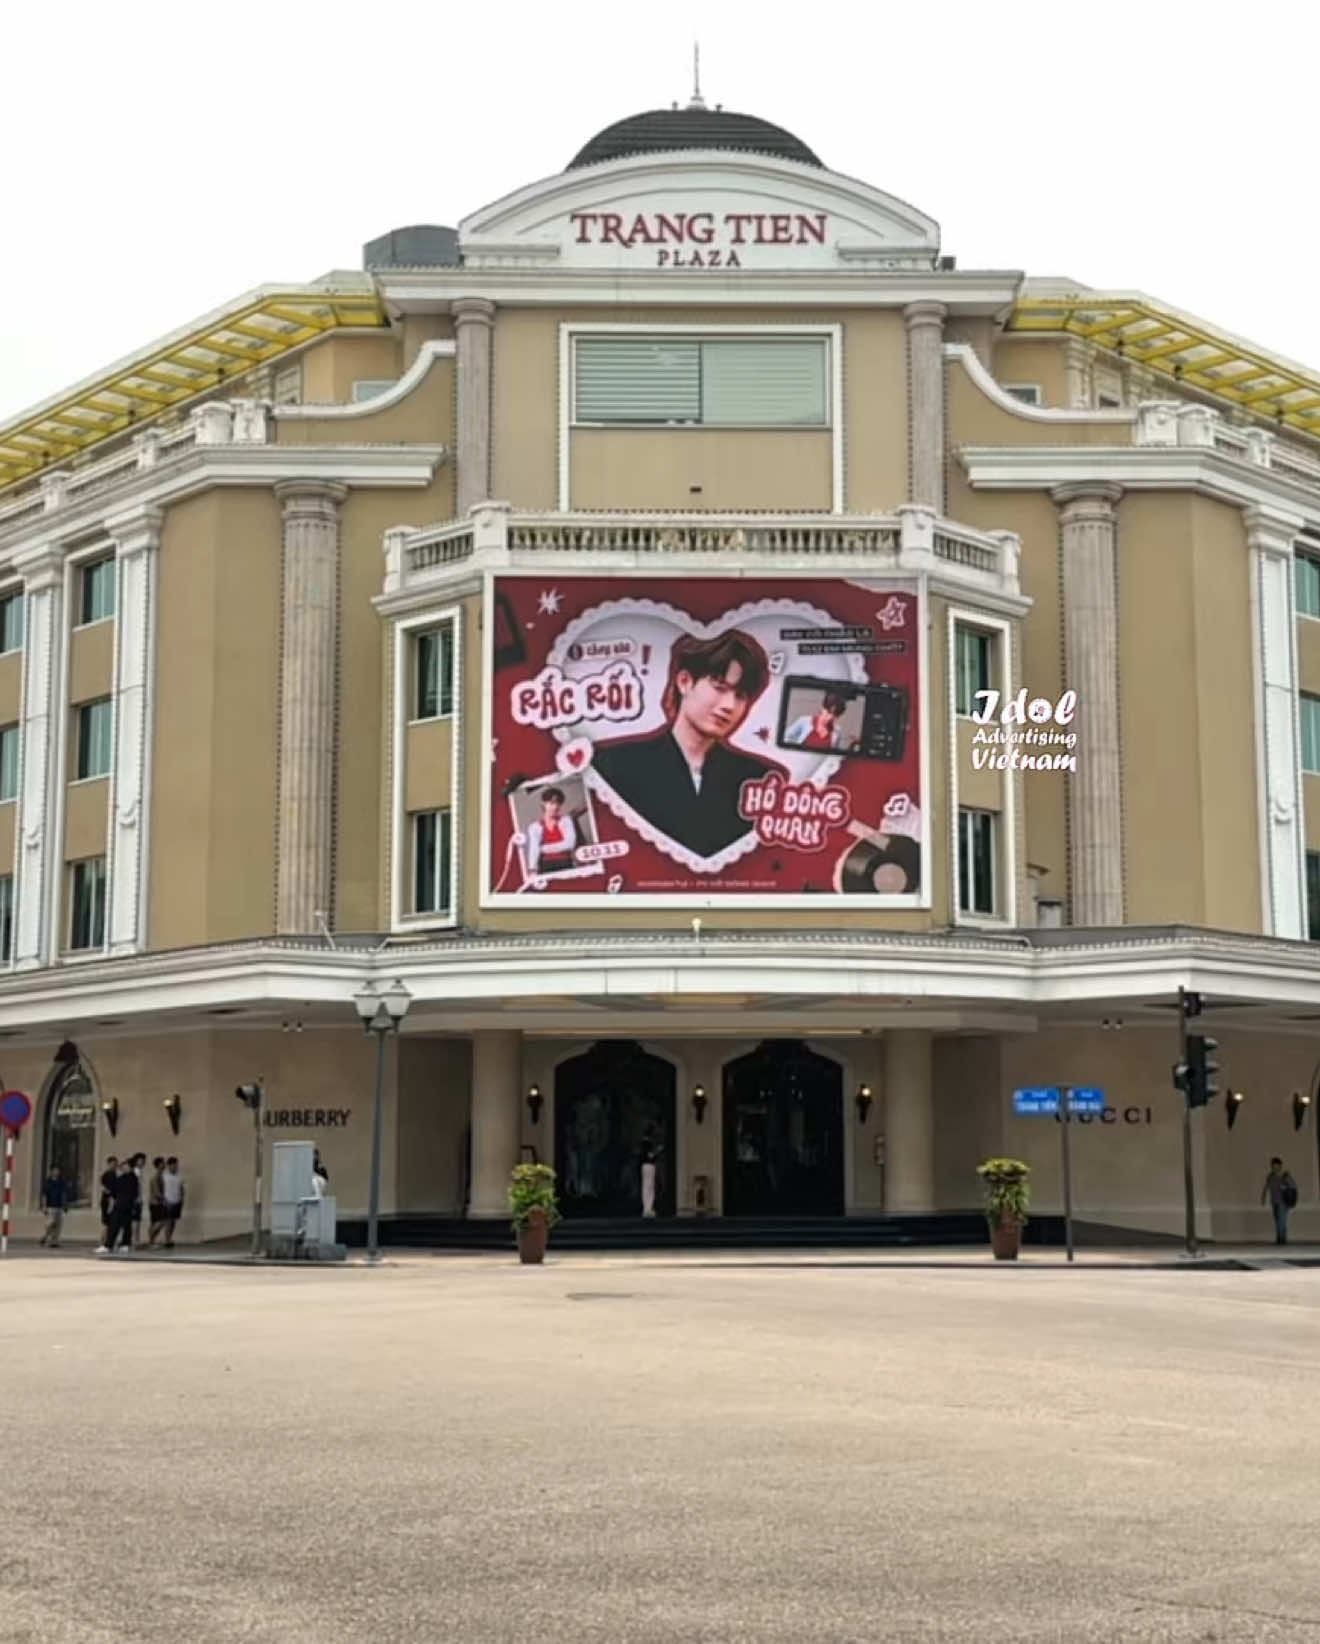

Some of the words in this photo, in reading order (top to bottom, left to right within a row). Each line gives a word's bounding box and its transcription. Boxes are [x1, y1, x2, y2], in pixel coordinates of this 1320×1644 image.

[570, 212, 716, 248] TRANG
[724, 213, 828, 245] TIEN
[656, 249, 742, 267] PLAZA
[262, 1108, 351, 1128] URBERRY
